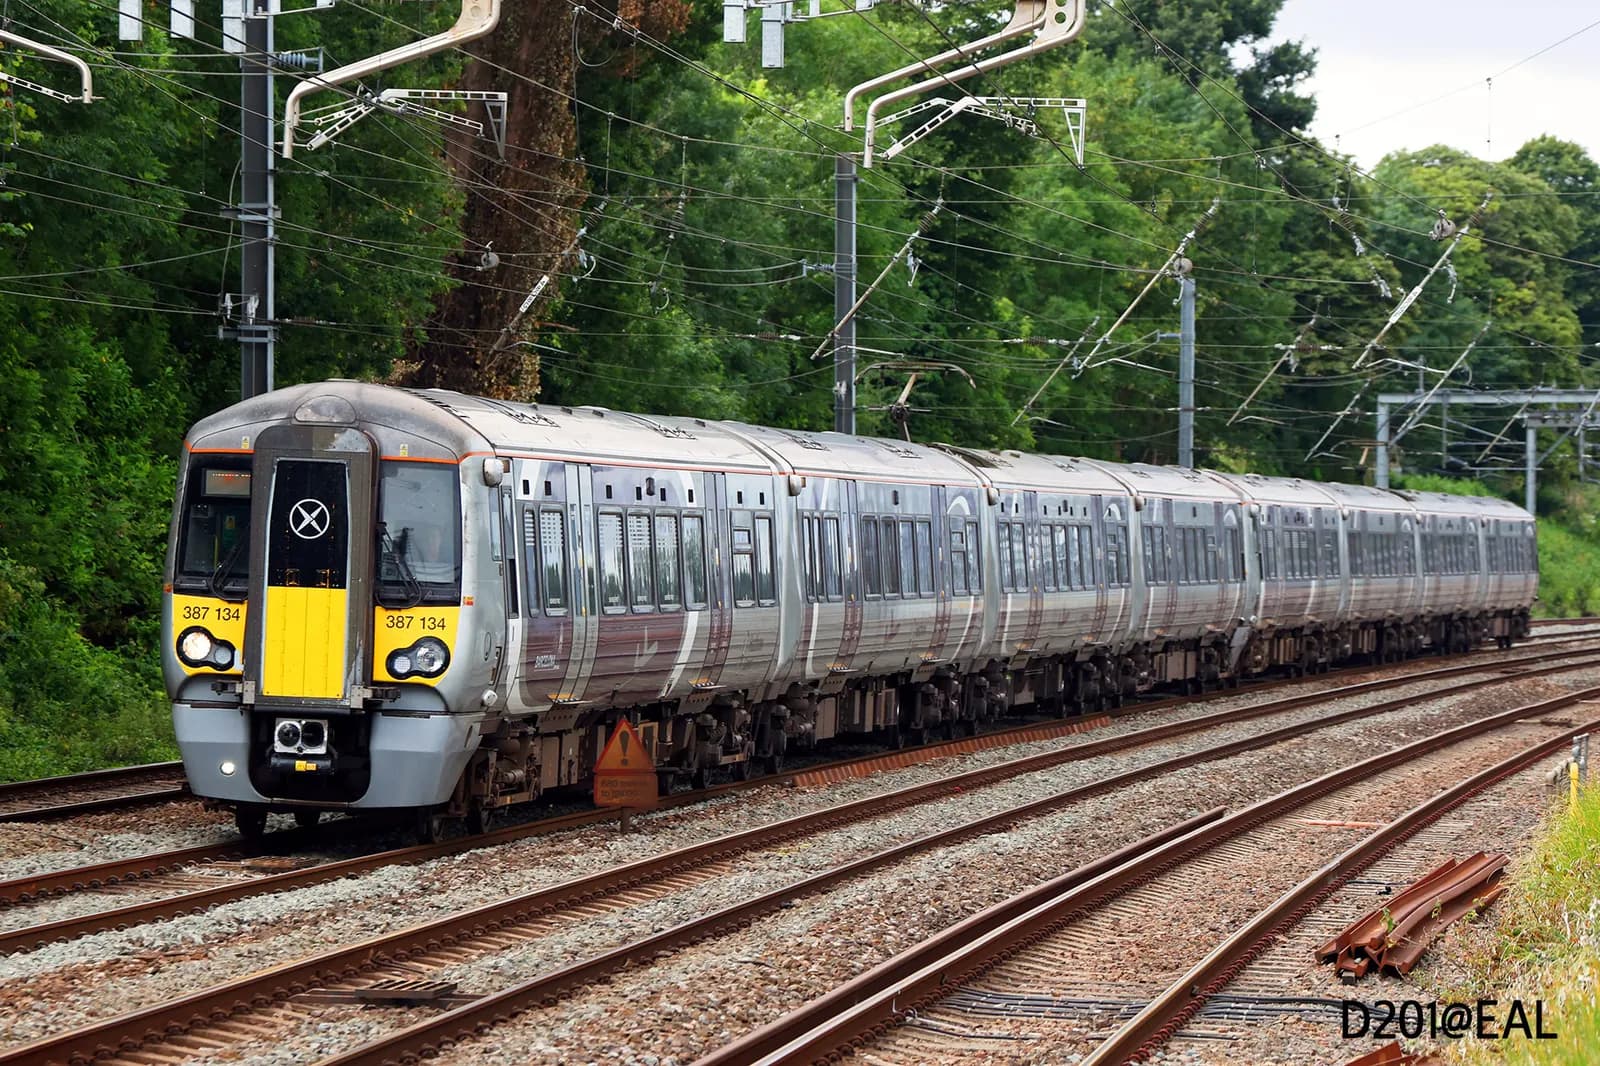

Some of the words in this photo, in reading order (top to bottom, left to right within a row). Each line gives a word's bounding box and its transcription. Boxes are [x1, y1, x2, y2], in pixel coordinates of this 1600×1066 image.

[183, 606, 209, 620] 387
[216, 608, 240, 621] 134
[386, 615, 414, 629] 387
[420, 617, 446, 630] 134
